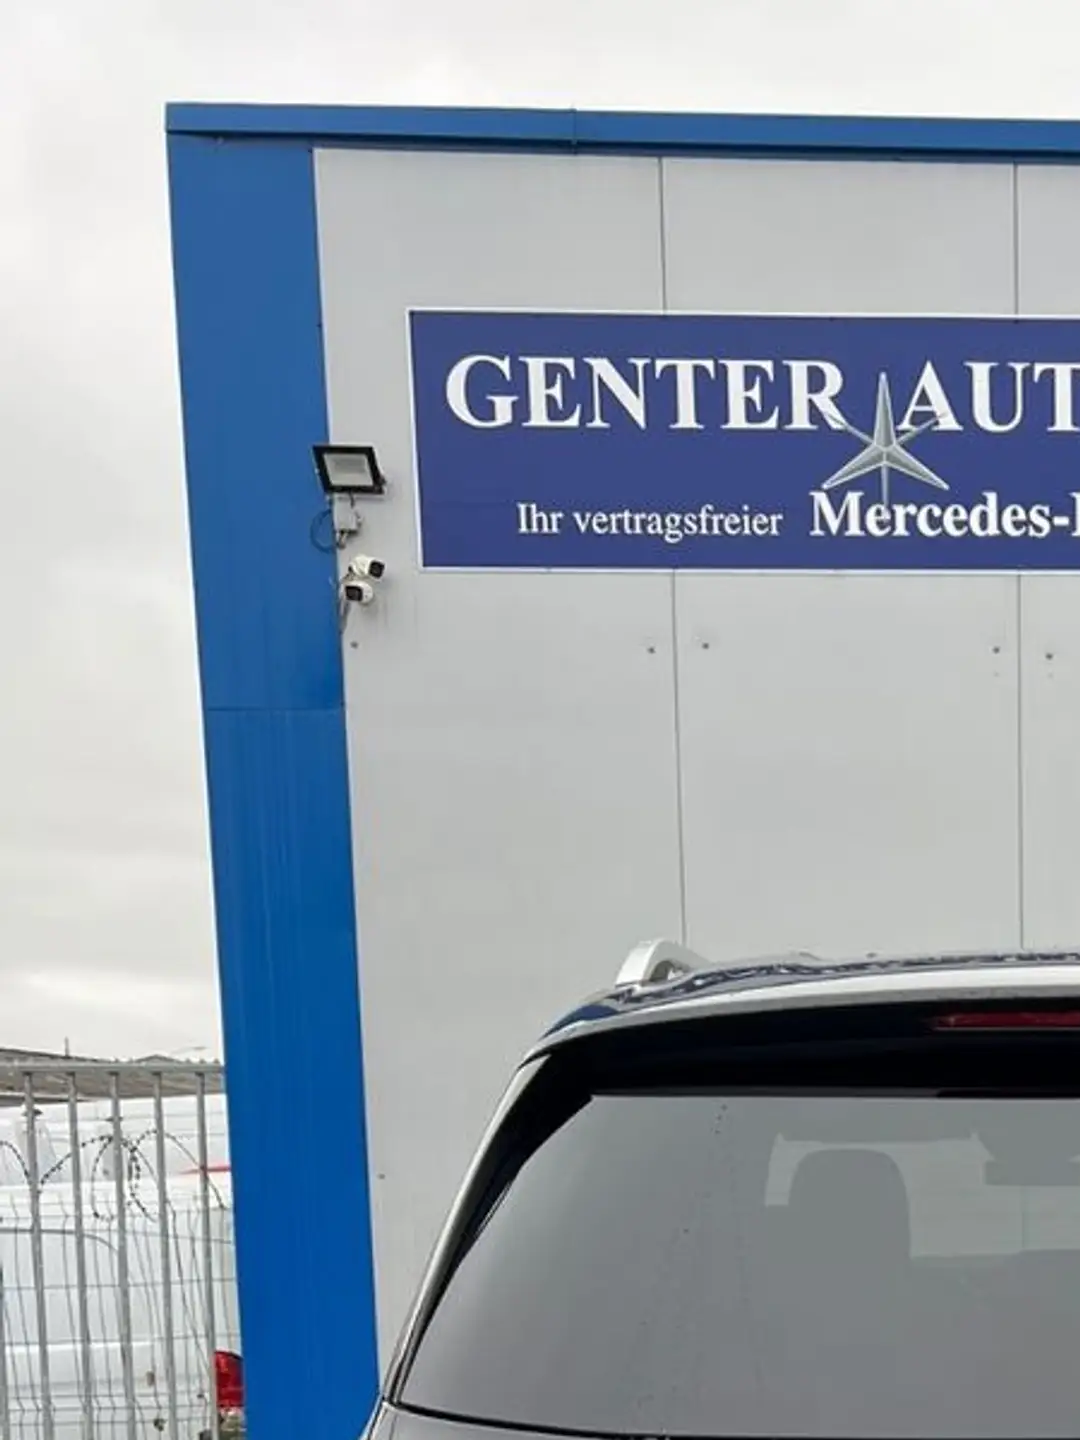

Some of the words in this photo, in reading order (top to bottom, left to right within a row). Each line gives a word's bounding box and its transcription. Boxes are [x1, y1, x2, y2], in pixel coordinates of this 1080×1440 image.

[446, 355, 845, 430] GENTER
[518, 503, 562, 534] Ihr
[574, 504, 783, 543] vertragsfreier
